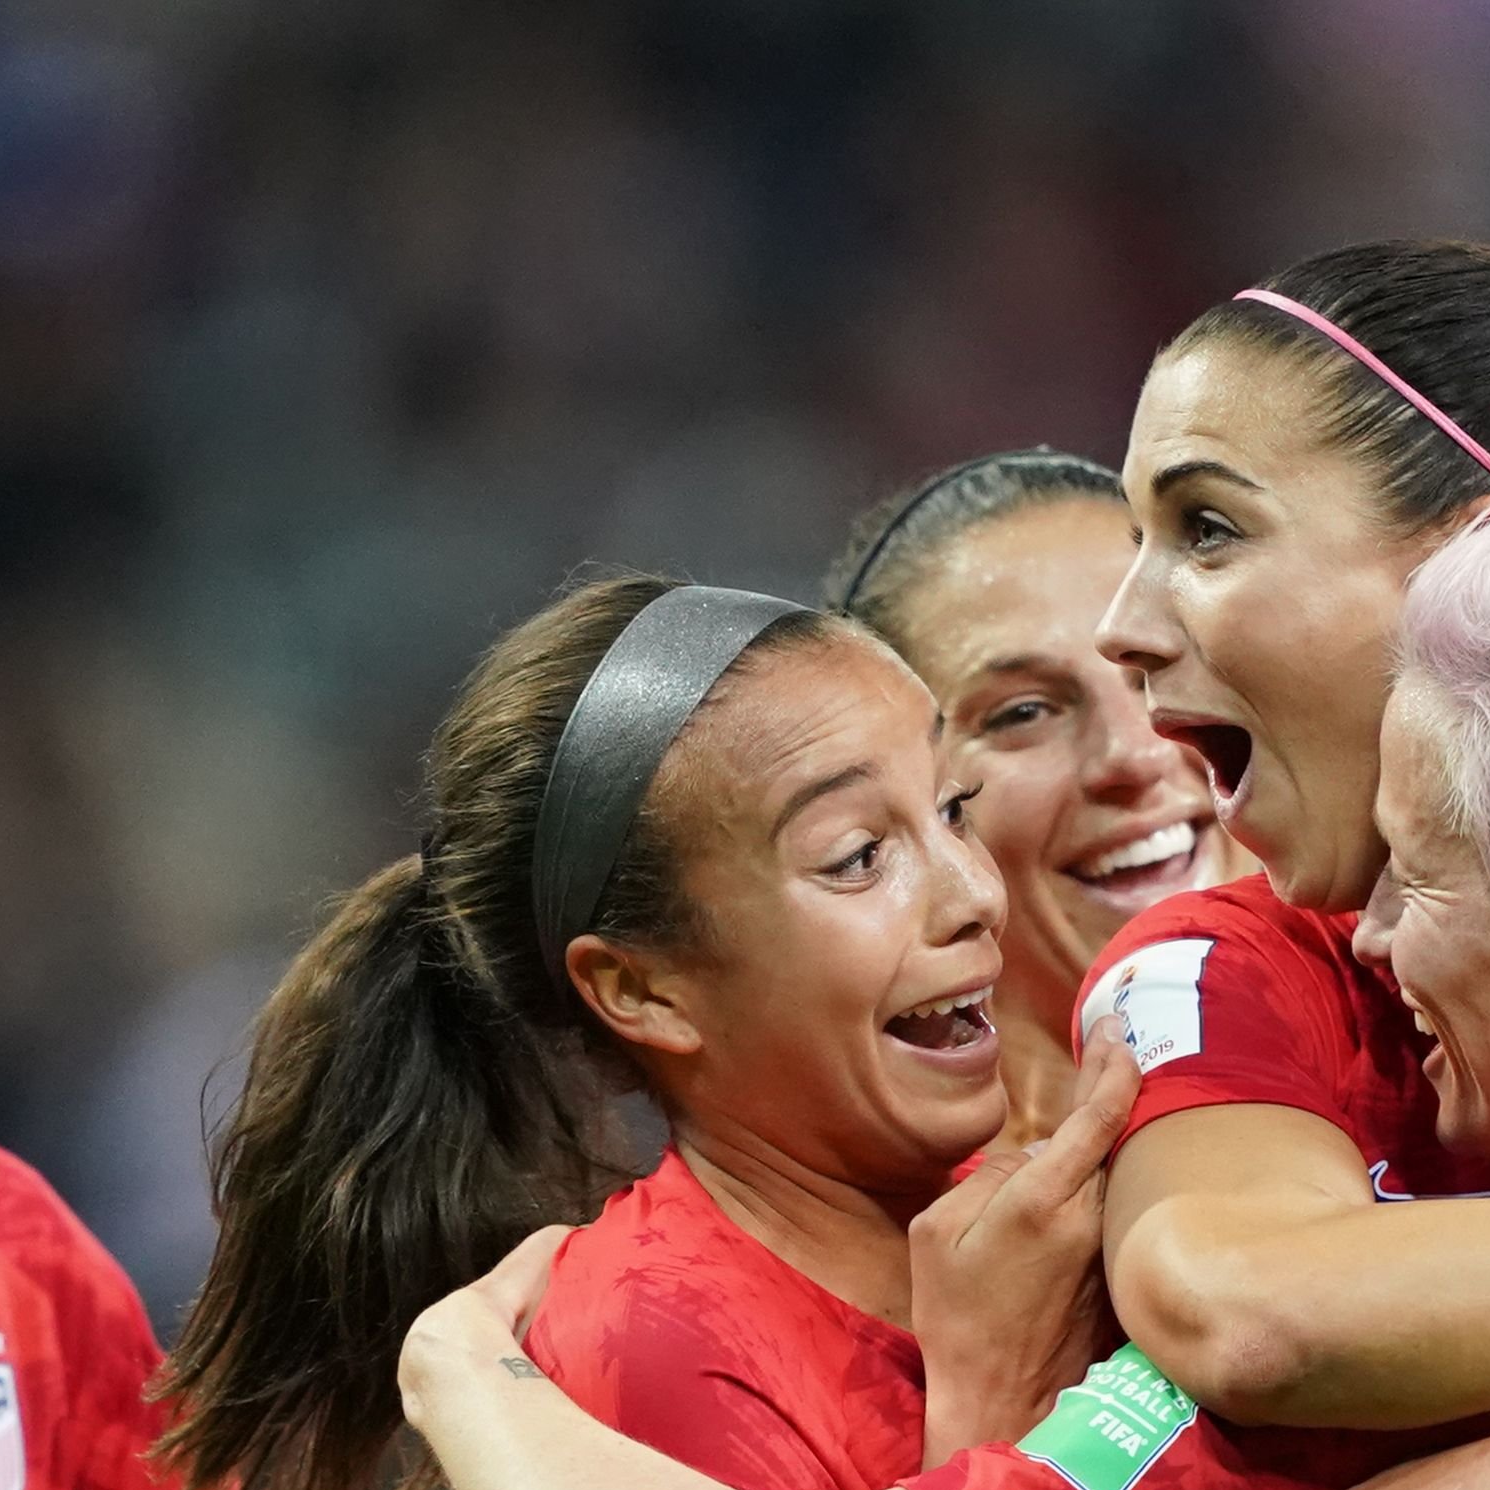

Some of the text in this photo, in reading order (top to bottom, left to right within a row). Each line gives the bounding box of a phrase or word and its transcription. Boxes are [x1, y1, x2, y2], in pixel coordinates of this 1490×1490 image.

[1140, 1039, 1175, 1067] 2019
[1088, 1373, 1172, 1423] OOTBALL
[1089, 1410, 1145, 1457] FIFA
